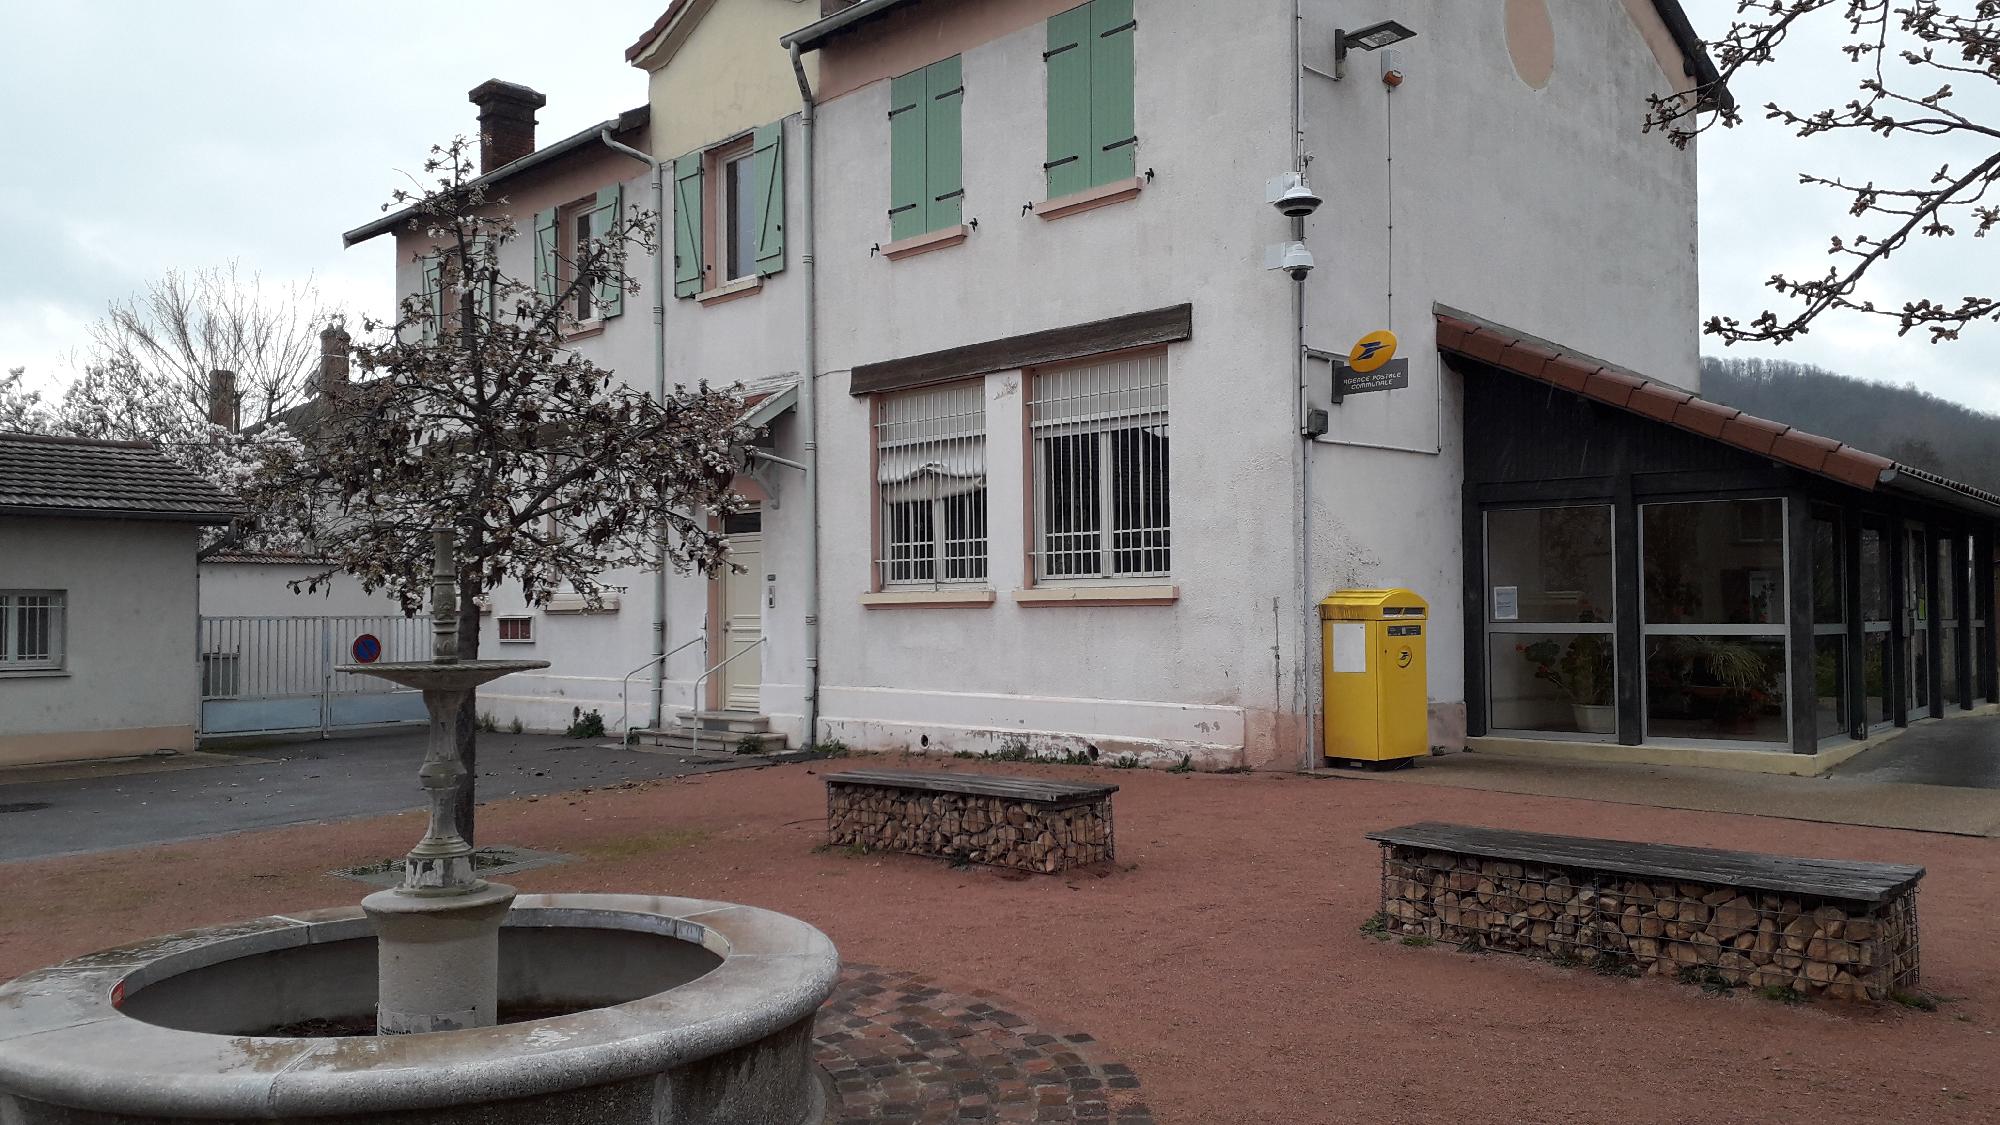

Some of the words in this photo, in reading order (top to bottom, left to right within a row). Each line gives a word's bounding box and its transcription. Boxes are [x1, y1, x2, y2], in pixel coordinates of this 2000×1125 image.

[1343, 376, 1370, 385] AGENCE
[1372, 371, 1402, 380] POSTALE
[1351, 379, 1393, 390] COMMUNALE
